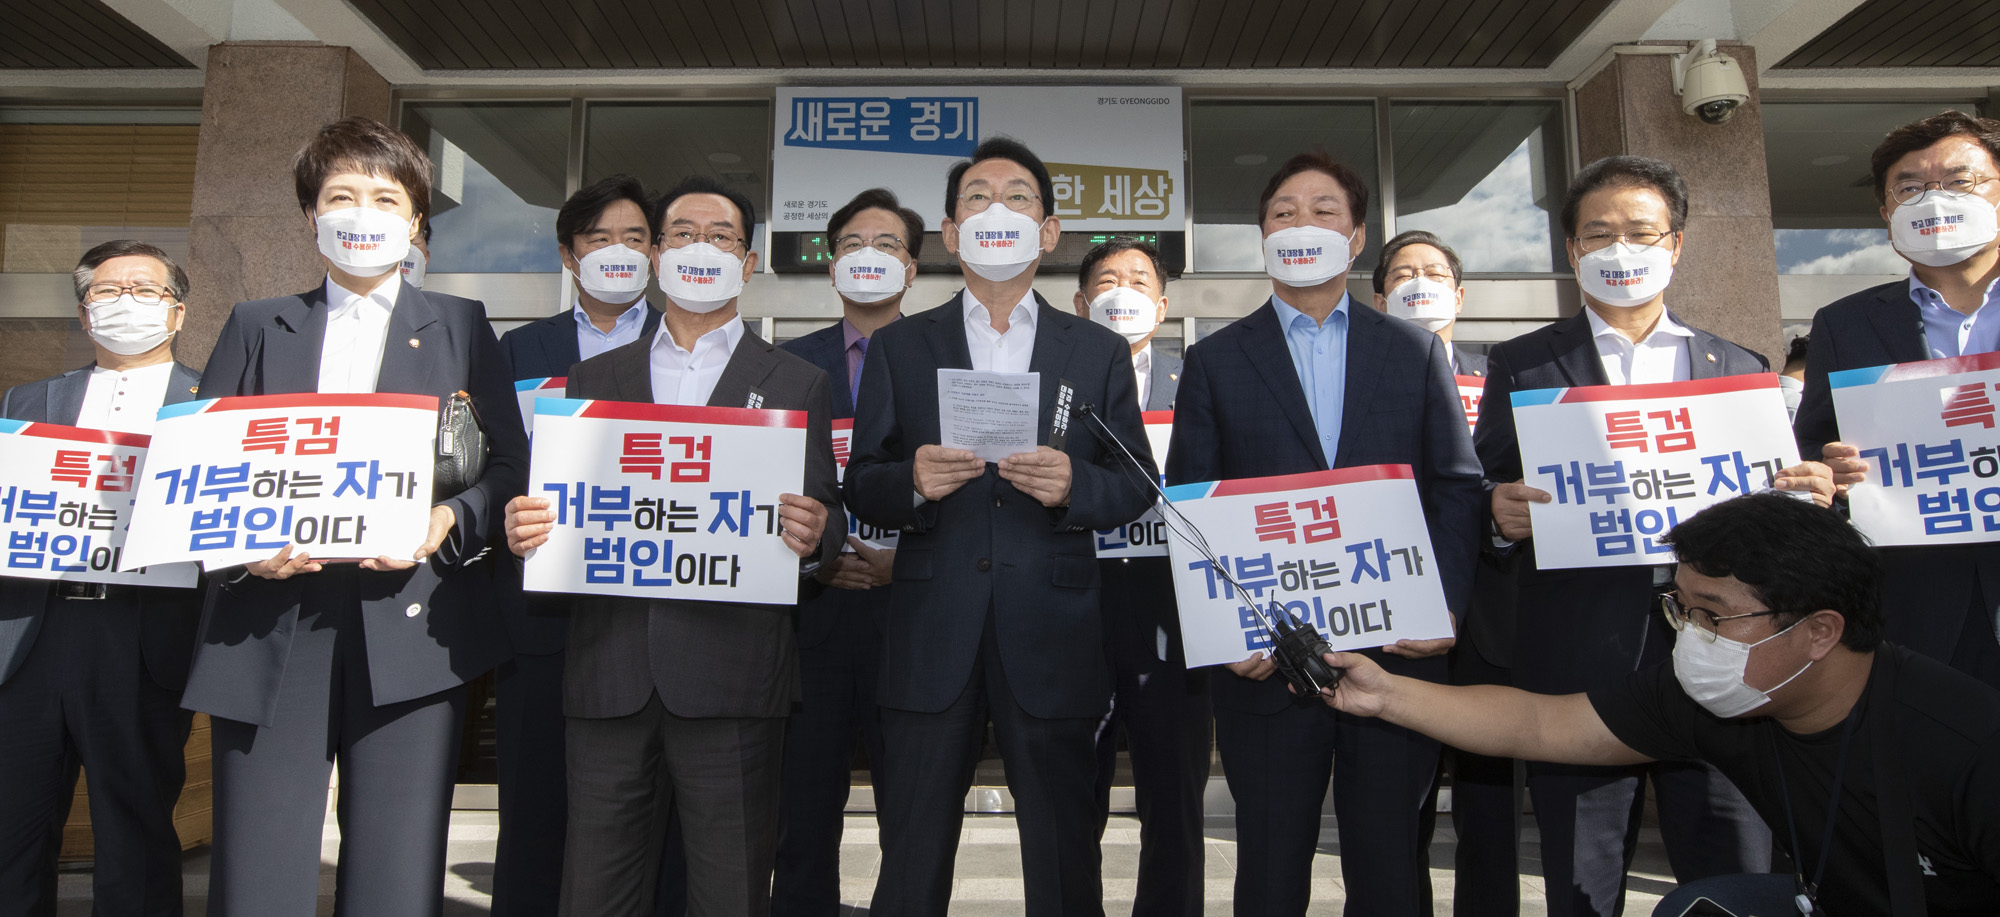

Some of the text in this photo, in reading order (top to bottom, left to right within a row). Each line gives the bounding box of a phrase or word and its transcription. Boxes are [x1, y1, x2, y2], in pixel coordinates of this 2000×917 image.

[788, 101, 974, 142] 새로운 경기
[1097, 97, 1170, 105] 경기도 GYEONGGIDO
[783, 200, 829, 208] 새로운 경기도
[783, 212, 829, 220] 공정한 세상의
[1051, 173, 1169, 216] 한 세상
[1940, 382, 2000, 429] 특
[241, 416, 341, 455] 특검
[1605, 407, 1696, 454] 특검
[50, 450, 137, 492] 특검
[619, 433, 712, 483] 특검
[155, 459, 418, 505] 거부하는 자가
[1537, 459, 1697, 506] 거부하는
[189, 505, 367, 552] 범인이다
[543, 482, 699, 533] 거부하는
[1254, 495, 1342, 544] 특검
[1589, 506, 1679, 557] 범인
[584, 537, 741, 588] 범인이다
[1188, 538, 1424, 600] 거부하는 자가
